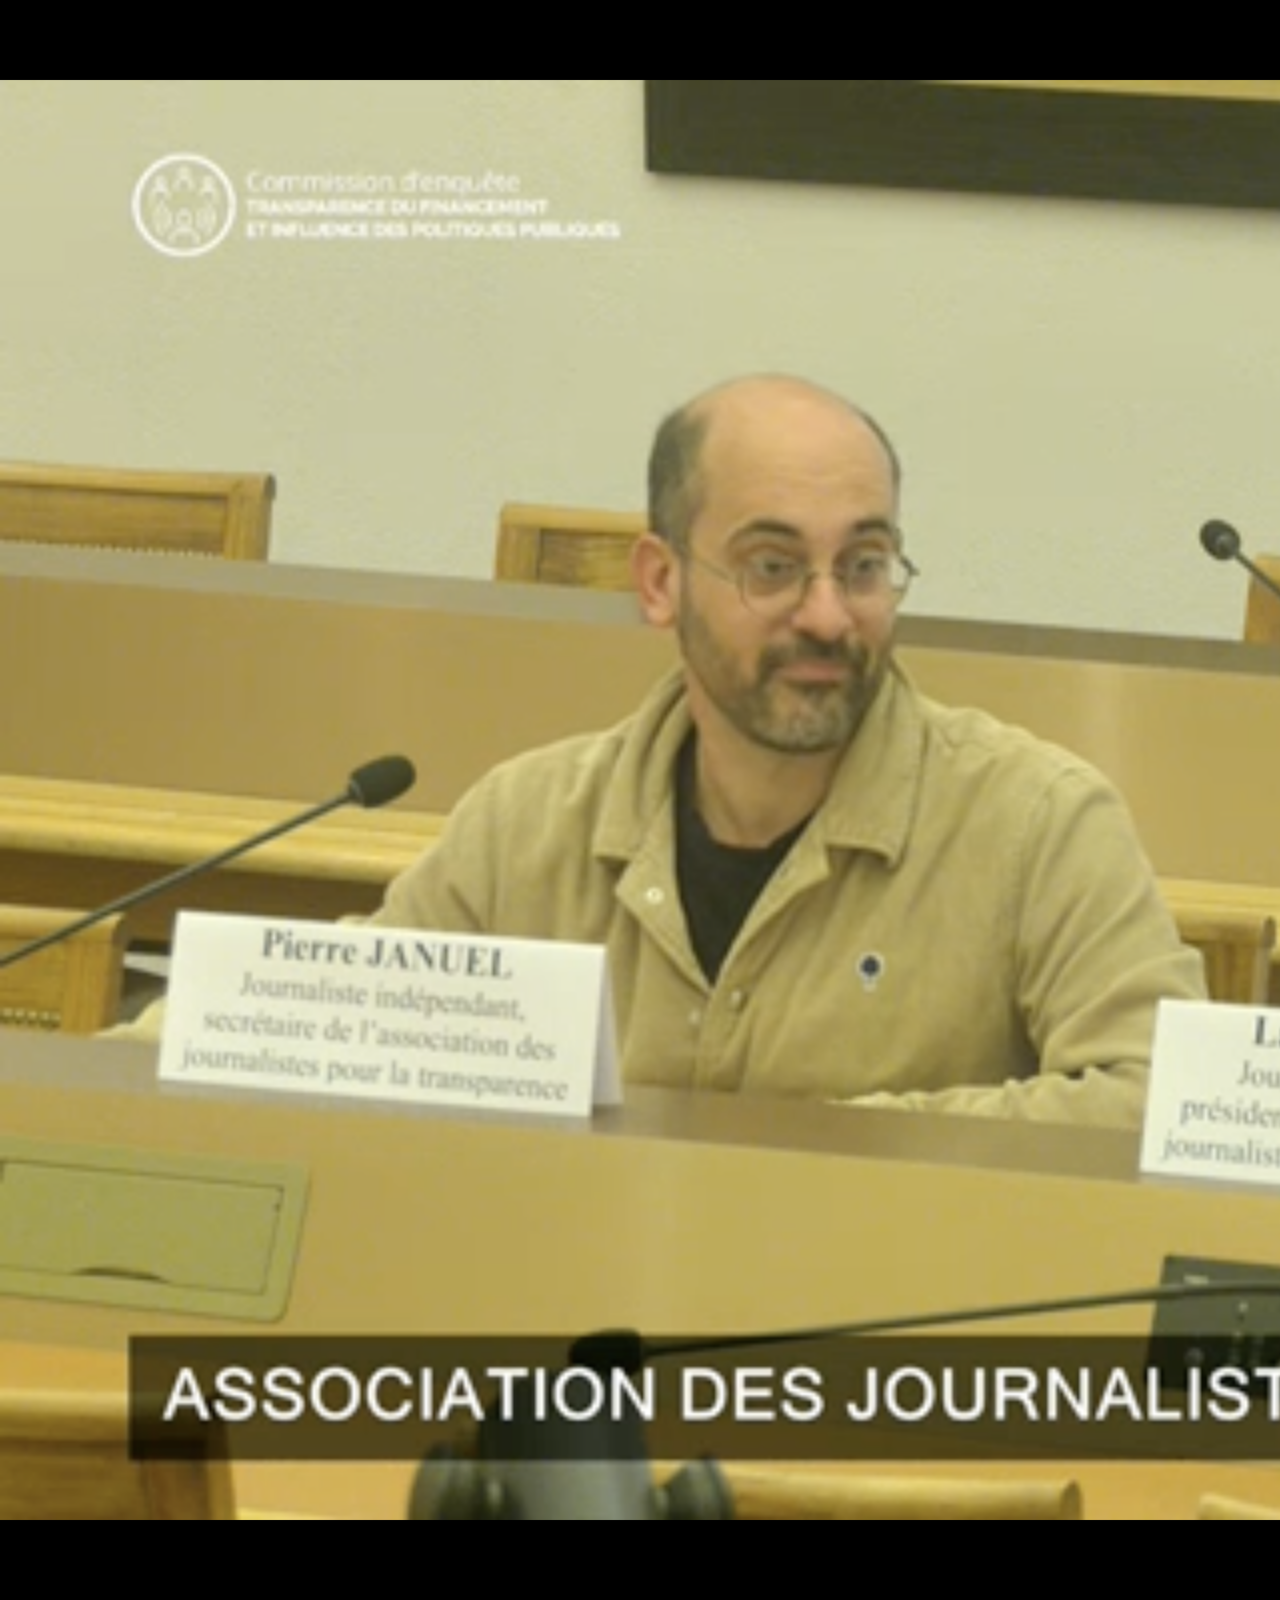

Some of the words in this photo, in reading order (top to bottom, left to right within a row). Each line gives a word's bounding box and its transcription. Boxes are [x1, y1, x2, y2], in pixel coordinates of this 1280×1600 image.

[262, 928, 357, 966] Pierre
[366, 937, 514, 979] JANUEL
[239, 971, 368, 1009] Journaliste
[375, 986, 526, 1023] indépendant,
[203, 1010, 315, 1041] secrétaire
[323, 1018, 352, 1044] de
[515, 1035, 556, 1062] des
[179, 1041, 320, 1079] journalistes
[326, 1057, 384, 1084] pour
[389, 1060, 410, 1087] la
[418, 1067, 569, 1101] transparence
